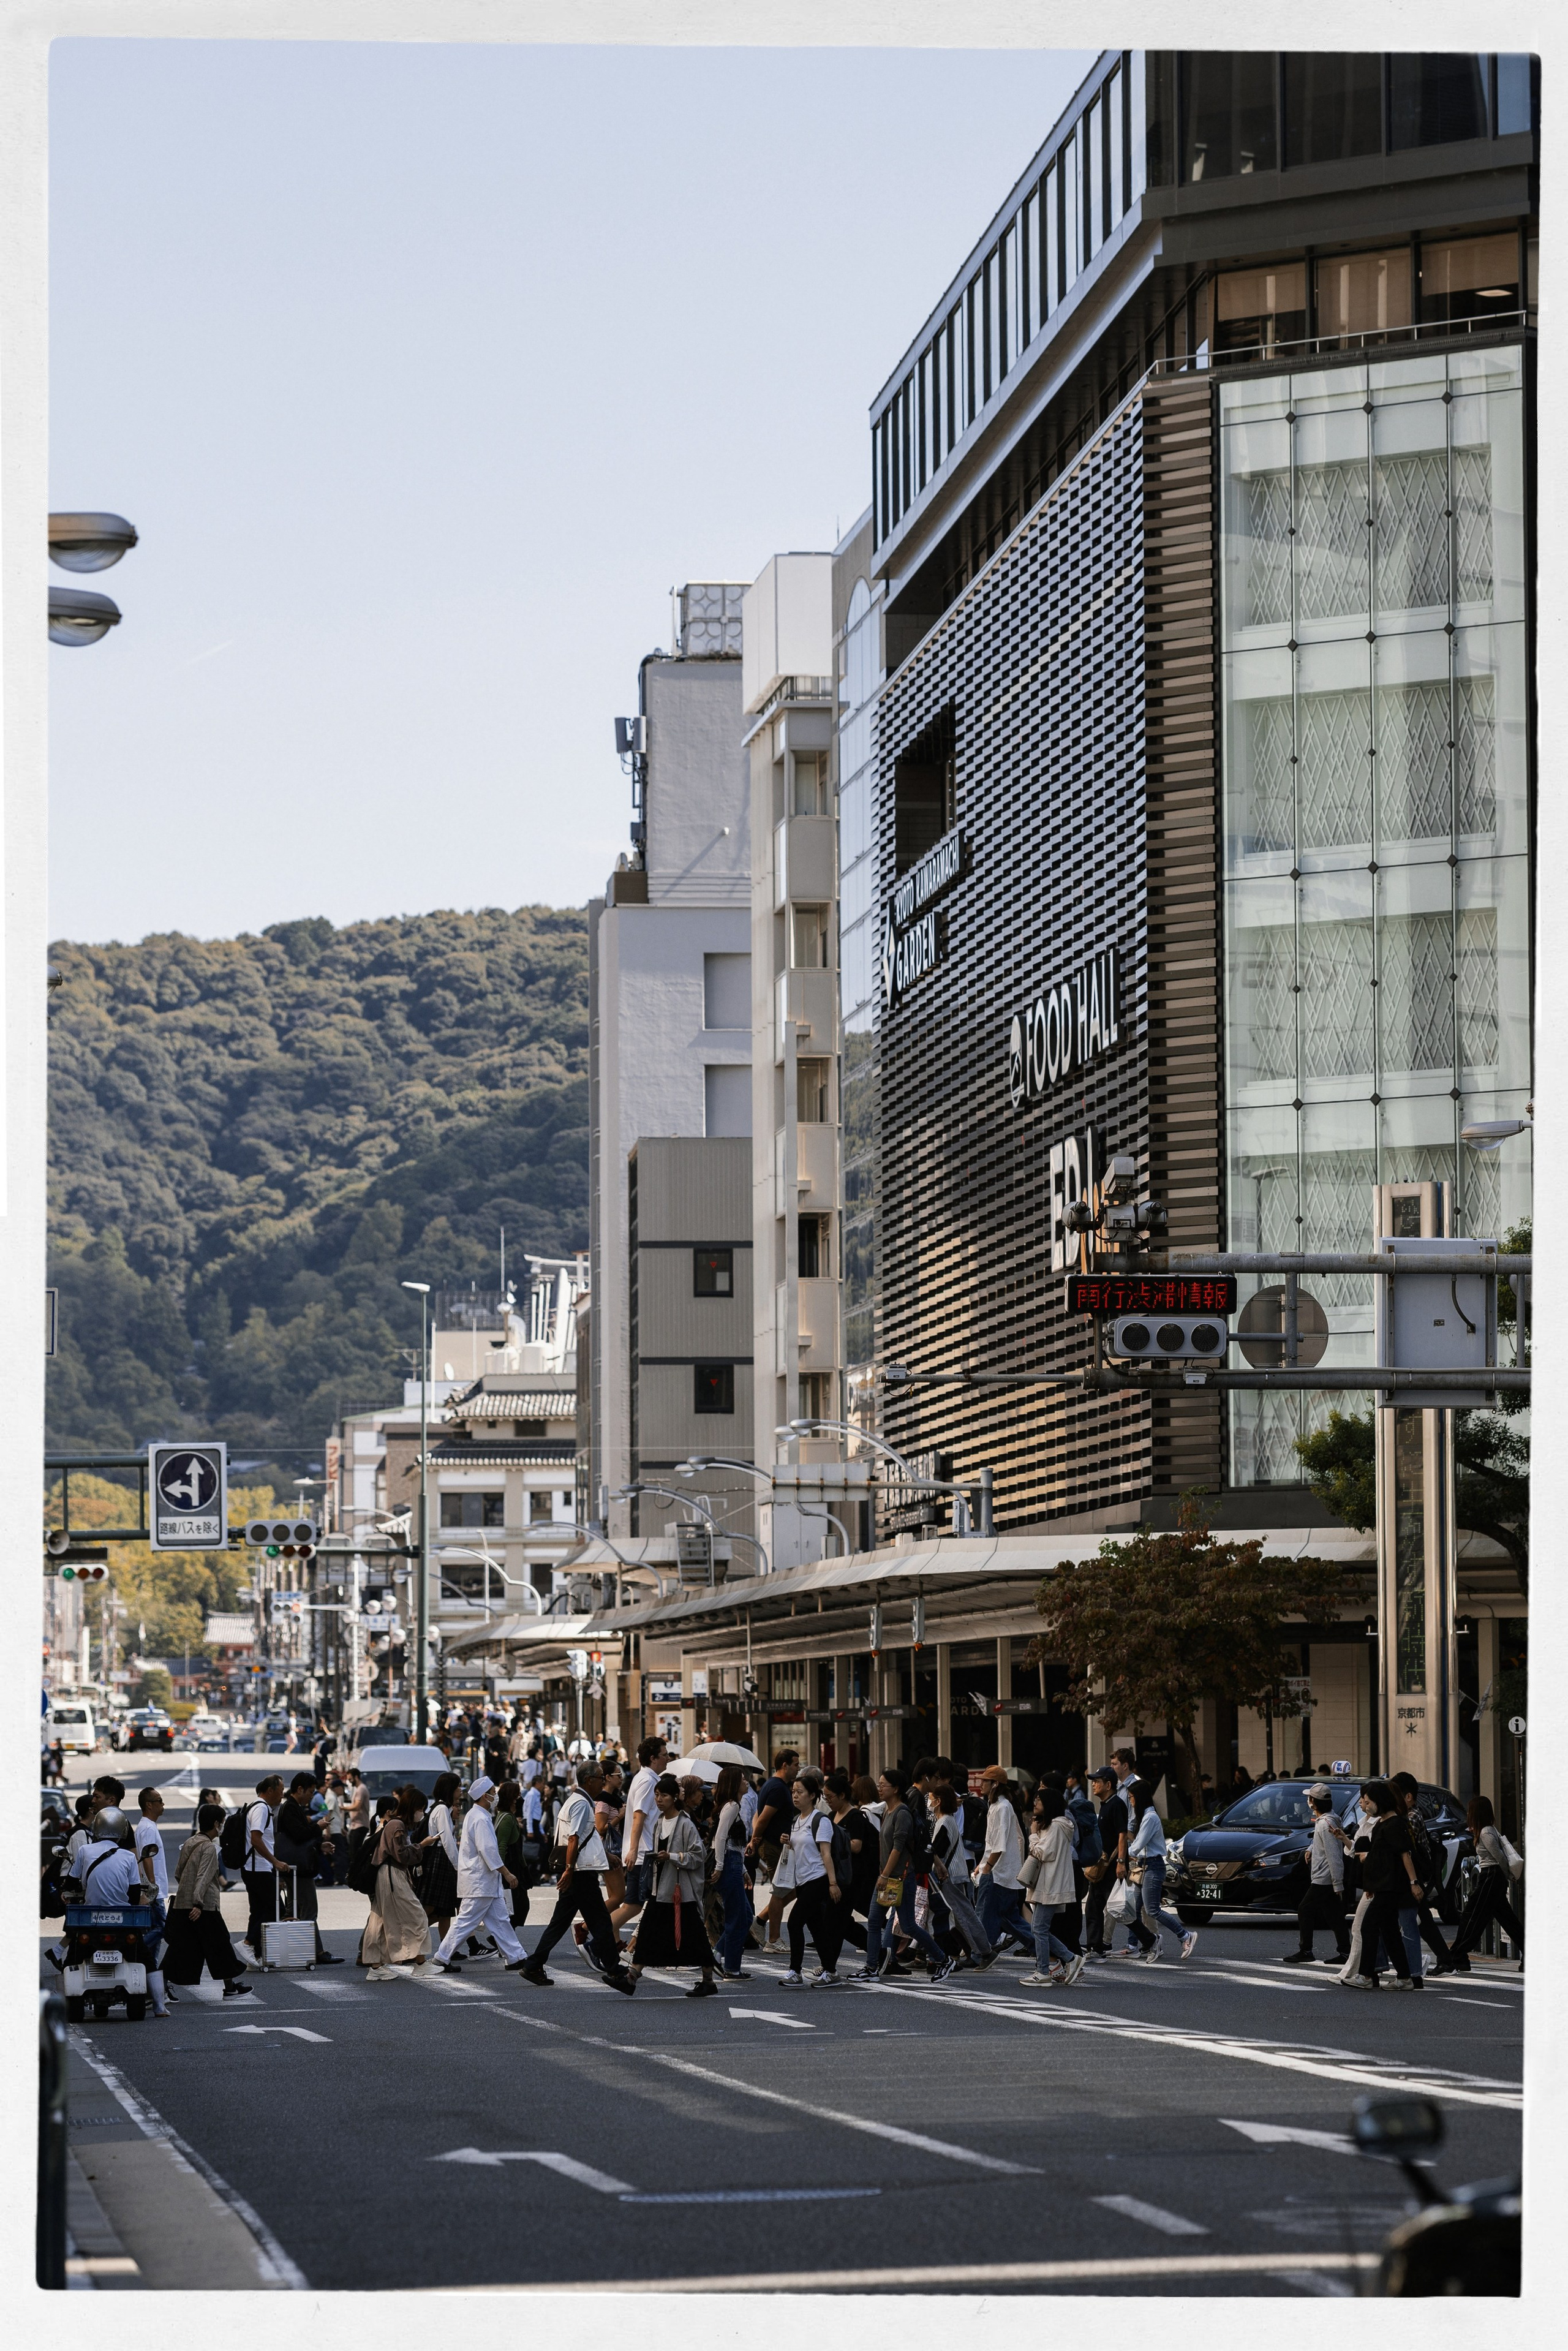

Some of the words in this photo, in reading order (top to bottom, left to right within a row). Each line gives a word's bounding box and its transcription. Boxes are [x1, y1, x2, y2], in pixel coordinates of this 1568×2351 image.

[895, 878, 914, 927] KYOTO
[916, 834, 960, 909] KAWARAMACHI
[896, 912, 935, 992] GARDEN
[1025, 982, 1072, 1097] FOOD
[1077, 948, 1118, 1065] HALL
[1076, 1281, 1228, 1309] 南行渋滞情報
[159, 1520, 219, 1535] 路線バスを除く
[1397, 1707, 1425, 1719] 京都市
[1200, 1889, 1221, 1899] 32-41
